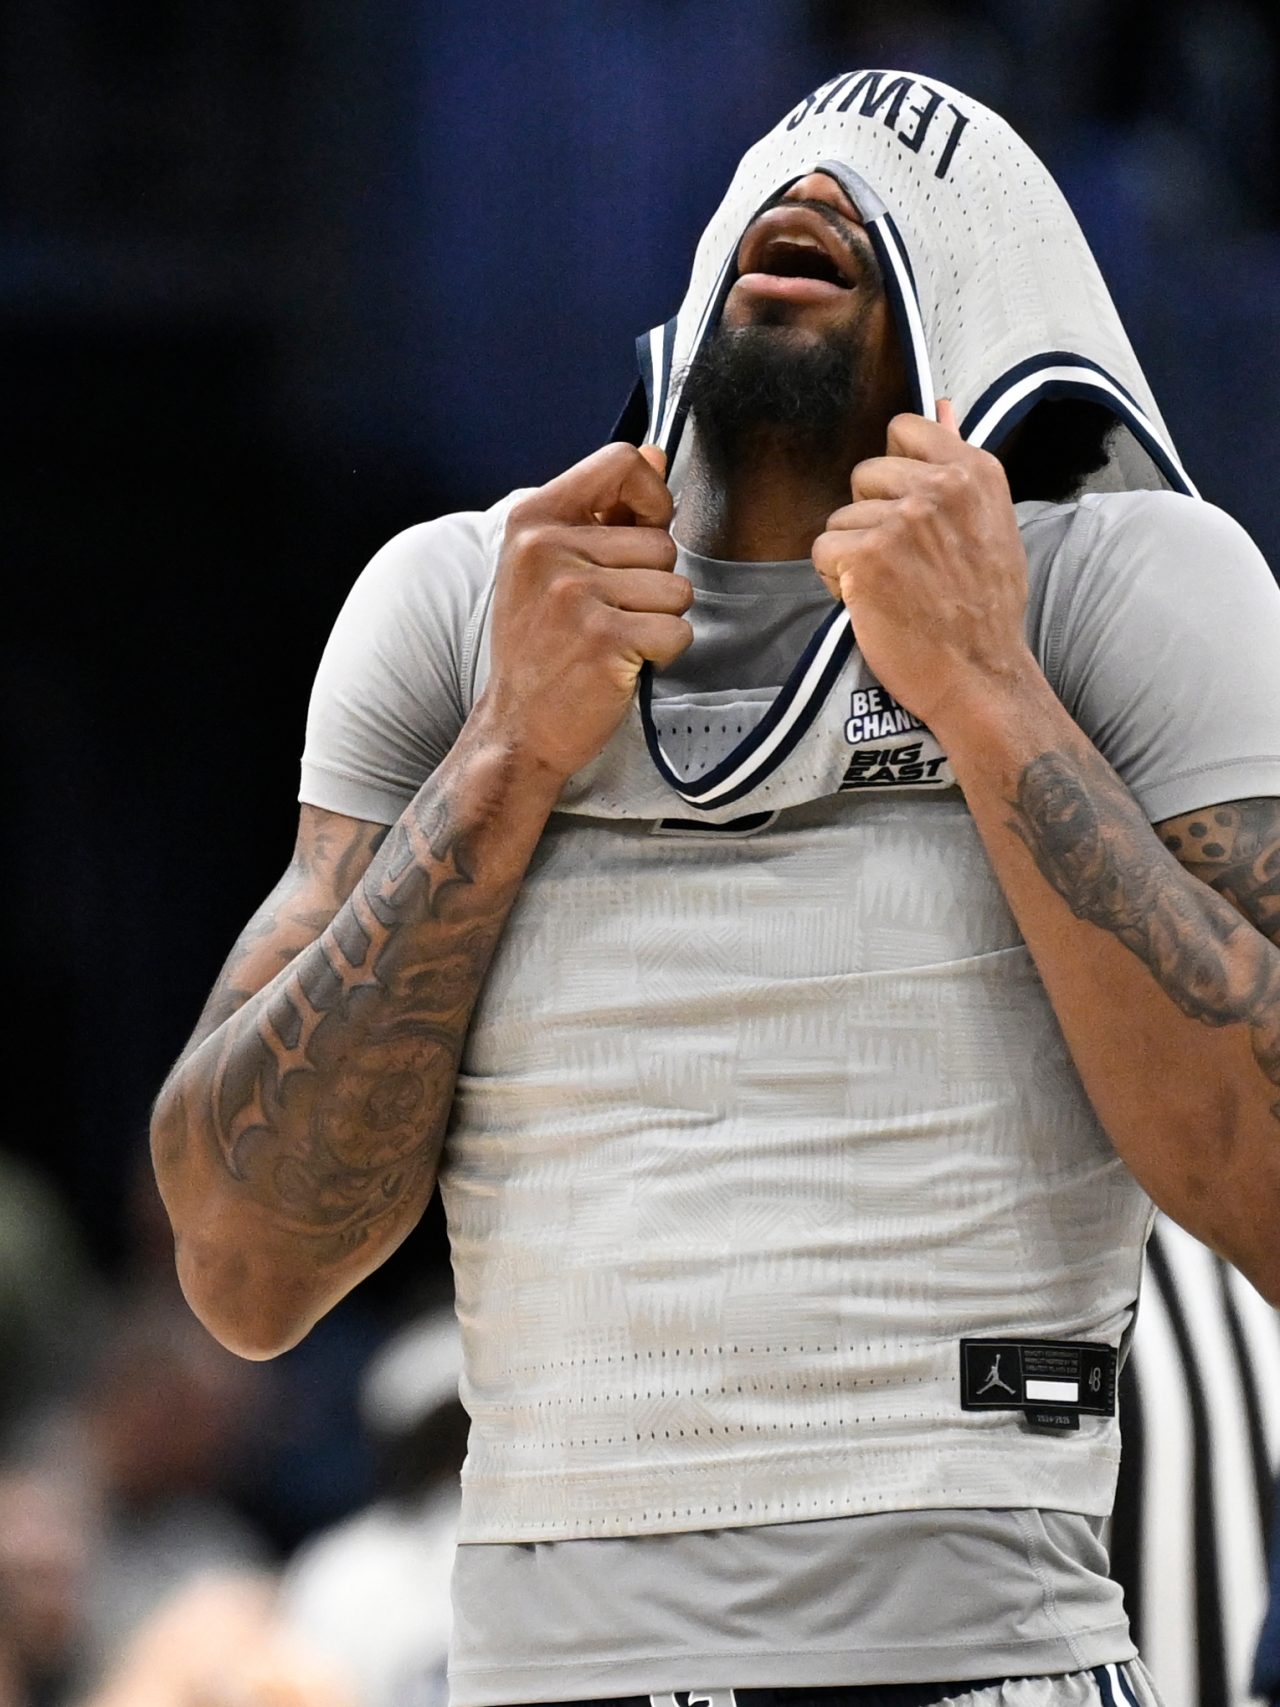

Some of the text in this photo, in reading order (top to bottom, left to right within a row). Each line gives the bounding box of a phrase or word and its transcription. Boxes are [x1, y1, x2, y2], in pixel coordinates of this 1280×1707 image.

[786, 71, 970, 180] LEWIS
[852, 689, 882, 717] BE
[850, 742, 923, 766] BIG
[843, 757, 948, 781] EAST
